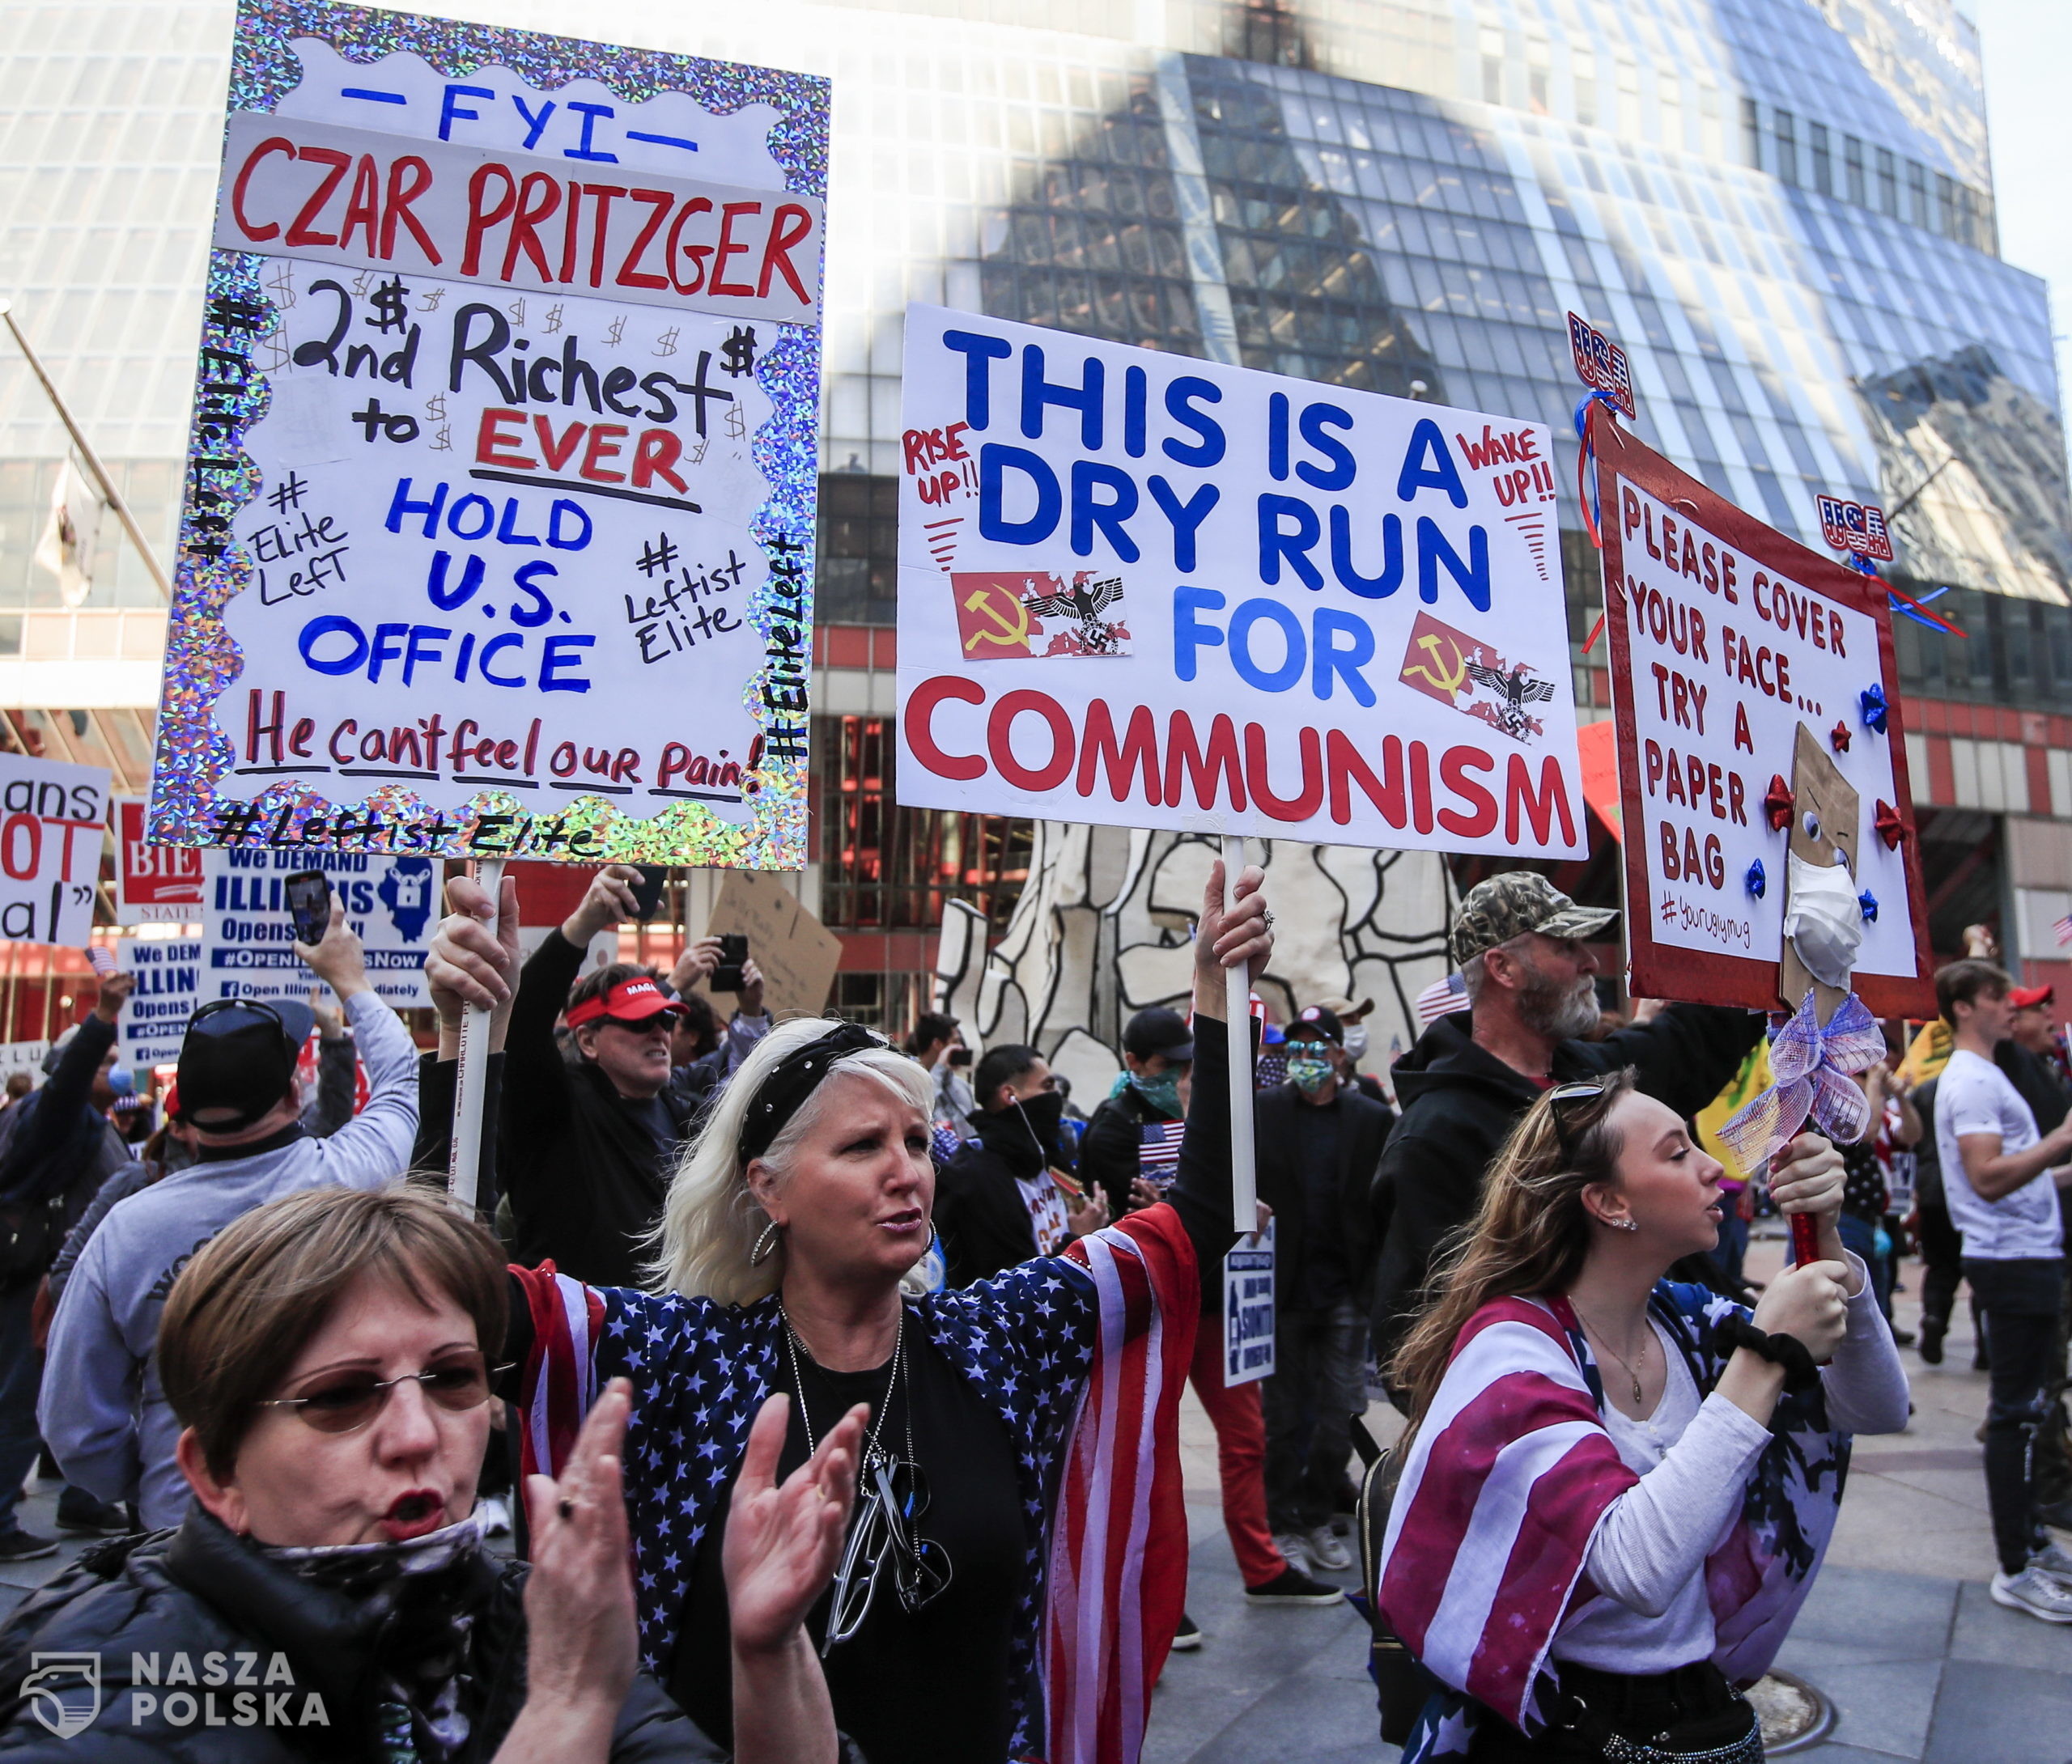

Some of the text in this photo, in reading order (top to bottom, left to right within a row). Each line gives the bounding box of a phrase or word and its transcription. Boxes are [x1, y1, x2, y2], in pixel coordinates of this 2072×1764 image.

[231, 136, 813, 307] CZAR PRITZGER
[292, 278, 734, 439] 2nd Richest
[351, 397, 690, 494] to EVER
[902, 421, 971, 475] RISE
[942, 329, 1469, 509] THIS IS A
[1455, 425, 1541, 471] WAKE
[384, 477, 593, 552] HOLD
[918, 460, 979, 508] UP!!
[1492, 460, 1556, 507] UP!!
[978, 442, 1492, 613] DRY RUN
[427, 550, 571, 627] U.S.
[625, 549, 746, 624] Leftist
[1623, 485, 1846, 659] PLEASE COVER
[298, 614, 597, 694] OFFICE
[635, 605, 742, 664] Elite
[1173, 585, 1378, 708] FOR
[1627, 574, 1822, 717] YOUR FACE...
[245, 688, 316, 766] He
[447, 717, 542, 778] feel
[1651, 661, 1755, 756] TRY A
[904, 674, 1577, 849] COMMUNISM
[1645, 738, 1748, 827] PAPER
[0, 809, 105, 883] OT
[129, 840, 197, 876] BIE
[229, 850, 368, 872] We DEMAND
[469, 814, 604, 857] Elite
[1660, 820, 1726, 890] BAG
[214, 875, 374, 914] ILLIIS
[128, 966, 200, 997] ILLIN
[134, 943, 202, 964] We DEM
[243, 983, 279, 999] Open
[284, 982, 331, 996] Illinis
[133, 999, 190, 1019] Opens
